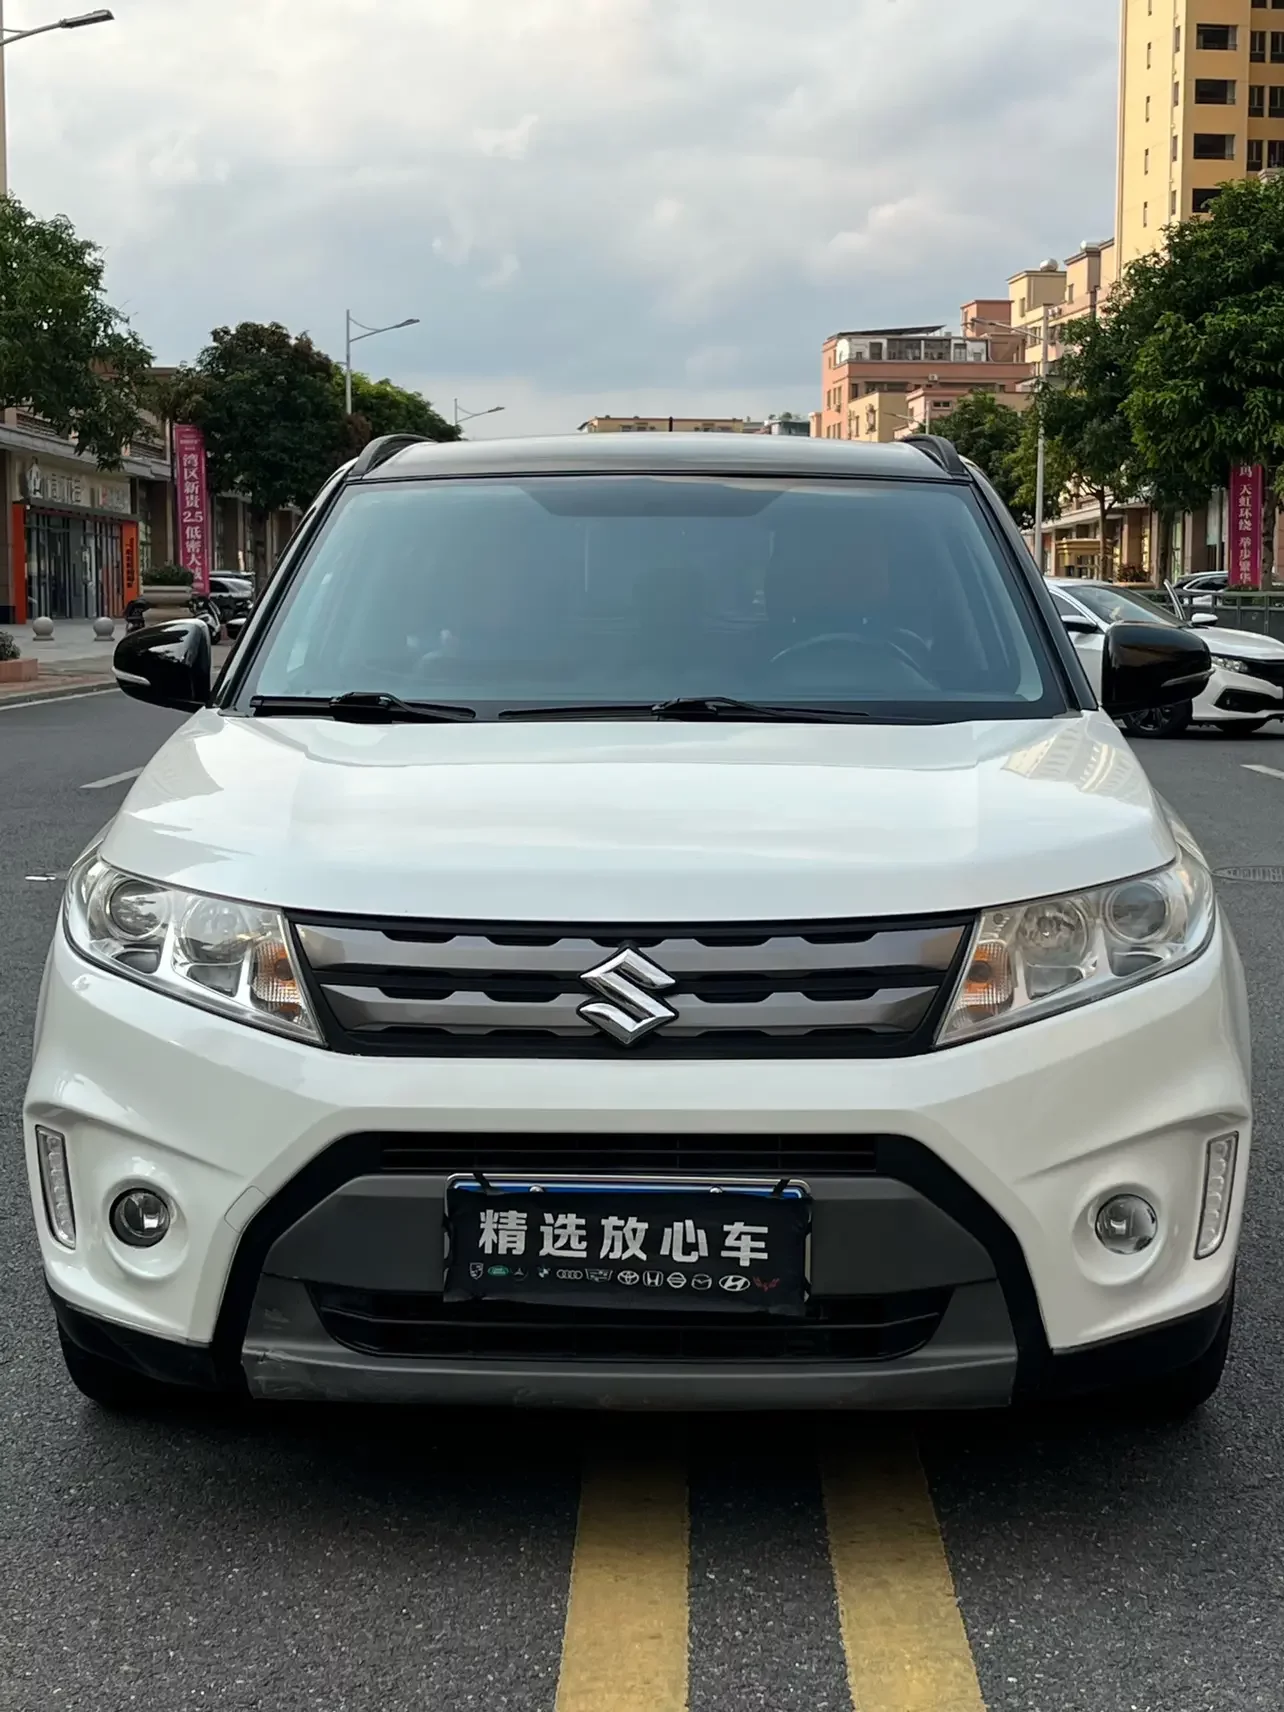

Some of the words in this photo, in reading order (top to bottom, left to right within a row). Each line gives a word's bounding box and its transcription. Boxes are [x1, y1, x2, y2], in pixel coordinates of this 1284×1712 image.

[478, 1208, 769, 1267] 精选放心车
